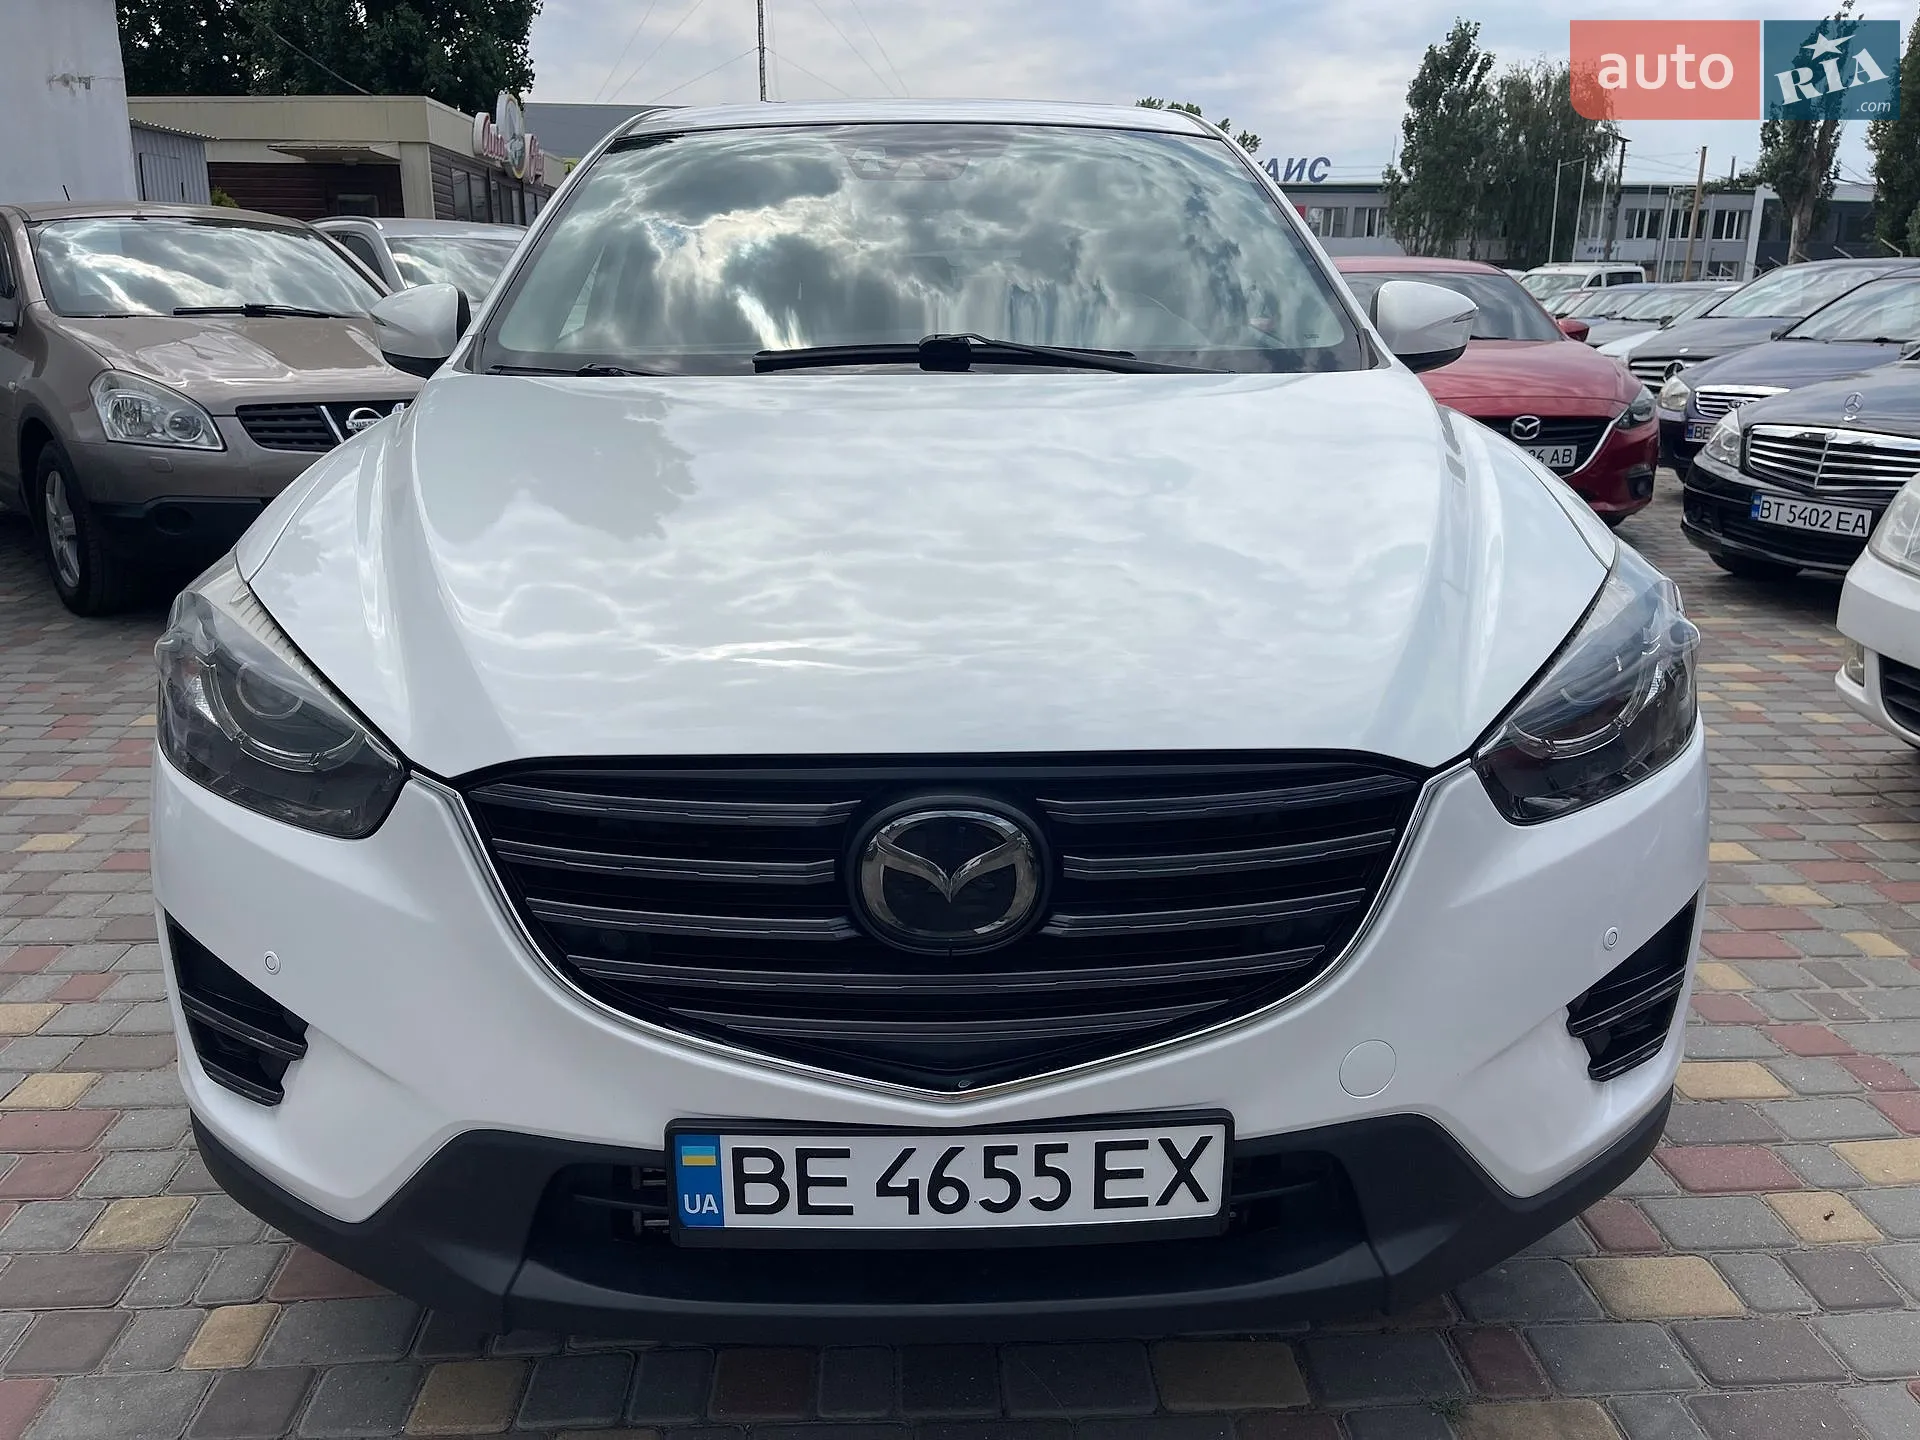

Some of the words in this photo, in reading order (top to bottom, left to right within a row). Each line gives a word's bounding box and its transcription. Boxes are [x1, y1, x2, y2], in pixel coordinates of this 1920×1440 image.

[1550, 449, 1572, 464] AB
[1760, 500, 1785, 522] BT
[1787, 505, 1830, 529] 5402
[1836, 512, 1866, 534] EA
[731, 1147, 854, 1216] BE
[875, 1143, 1072, 1216] 4655
[1094, 1135, 1214, 1210] EX
[683, 1194, 719, 1215] UA
